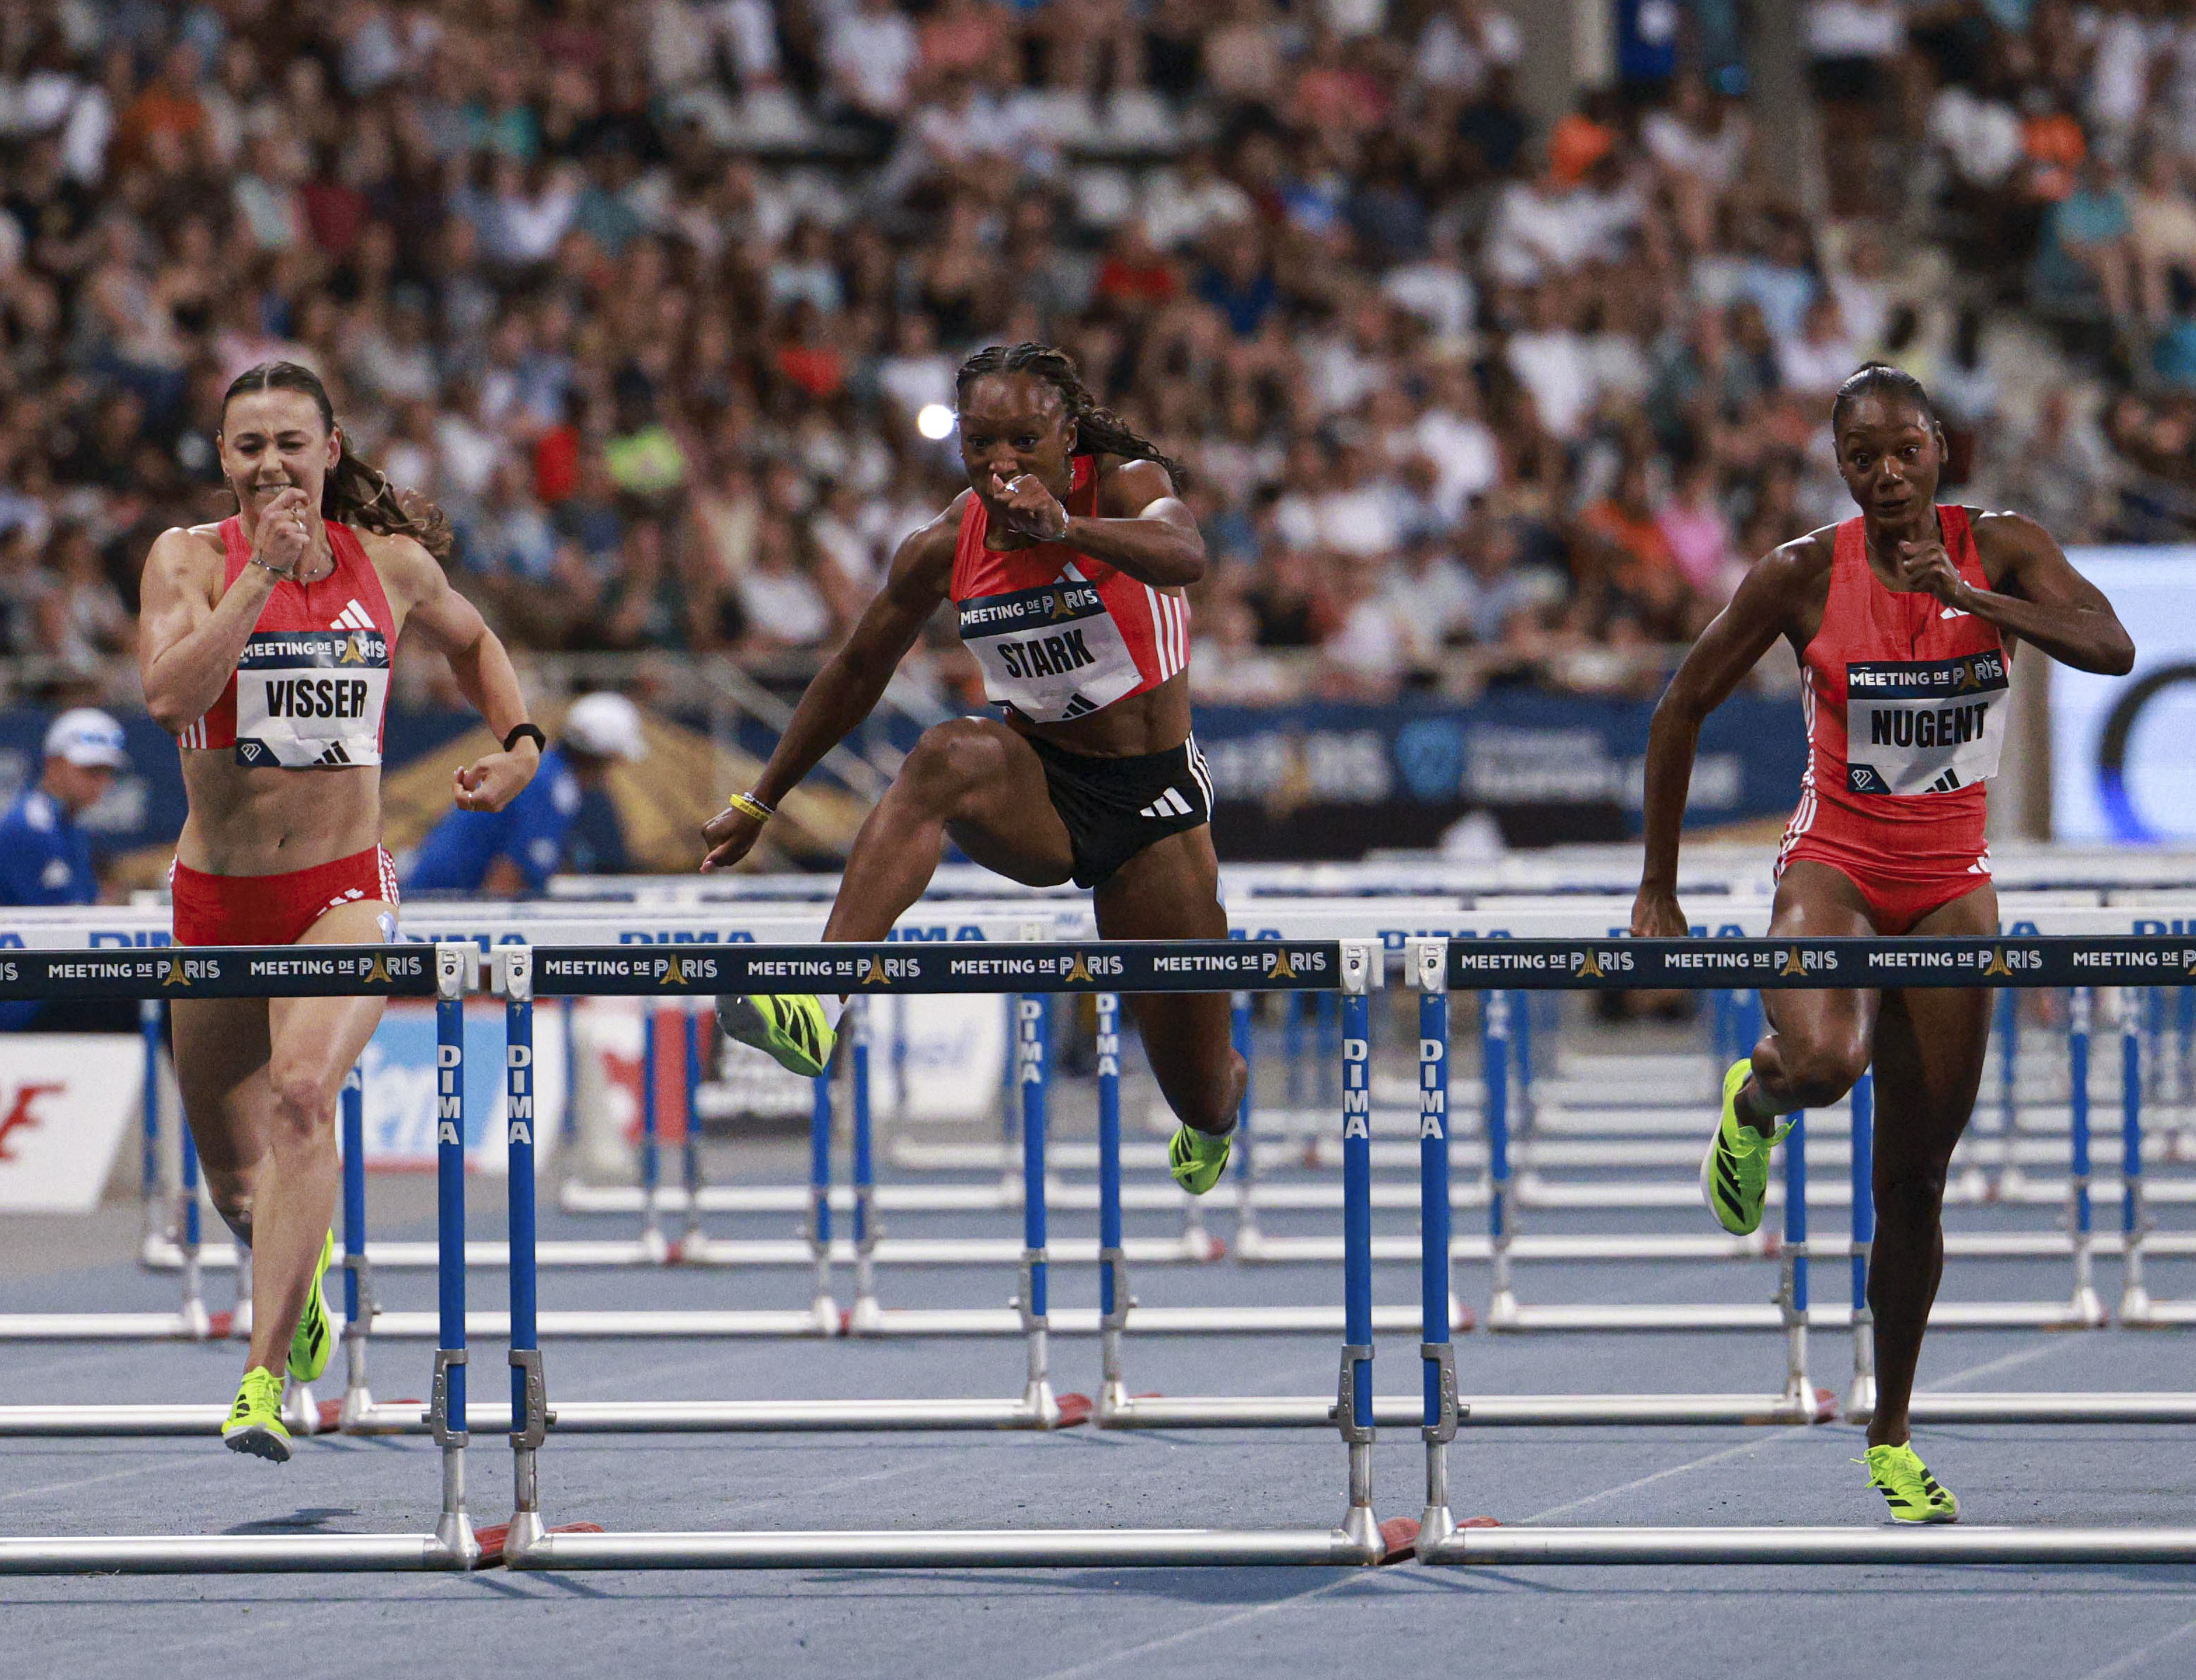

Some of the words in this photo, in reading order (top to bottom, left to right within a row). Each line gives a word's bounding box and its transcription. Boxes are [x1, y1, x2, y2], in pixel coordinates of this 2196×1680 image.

[960, 602, 1024, 625] MEETING
[1027, 599, 1041, 614] DE
[1042, 588, 1098, 619] PARIS
[241, 642, 314, 657] MEETING
[318, 642, 332, 655] DE
[335, 637, 386, 663] PARIS
[997, 628, 1096, 678] STARK
[1850, 672, 1929, 686] MEETING
[1934, 671, 1949, 685] DE
[1953, 659, 2003, 690] PARIS
[266, 679, 368, 718] VISSER
[1871, 702, 1988, 748] NUGENT
[48, 963, 132, 979] MEETING
[136, 963, 153, 977] DE
[156, 956, 221, 985] PARIS
[250, 960, 335, 975] MEETING
[339, 960, 355, 974] DE
[359, 954, 422, 982] PARIS
[546, 960, 629, 975] MEETING
[634, 961, 650, 975] DE
[654, 955, 718, 984] PARIS
[748, 961, 832, 976] MEETING
[836, 961, 853, 975] DE
[857, 955, 921, 984] PARIS
[950, 959, 1035, 975] MEETING
[1039, 959, 1056, 973] DE
[1060, 952, 1124, 981] PARIS
[1153, 956, 1237, 972] MEETING
[1241, 956, 1258, 970] DE
[1262, 949, 1326, 978] PARIS
[1462, 954, 1545, 970] MEETING
[1549, 954, 1566, 969] DE
[1570, 948, 1634, 977] PARIS
[1664, 953, 1749, 968] MEETING
[1753, 953, 1770, 967] DE
[1774, 947, 1838, 975] PARIS
[1868, 952, 1953, 968] MEETING
[1958, 952, 1974, 966] DE
[1978, 946, 2042, 975] PARIS
[2073, 951, 2158, 967] MEETING
[2162, 952, 2179, 966] DE
[1020, 999, 1043, 1084] DIMA
[1096, 993, 1119, 1077] DIMA
[438, 1045, 462, 1145] DIMA
[507, 1045, 532, 1144] DIMA
[1344, 1038, 1368, 1139] DIMA
[1420, 1038, 1444, 1139] DIMA
